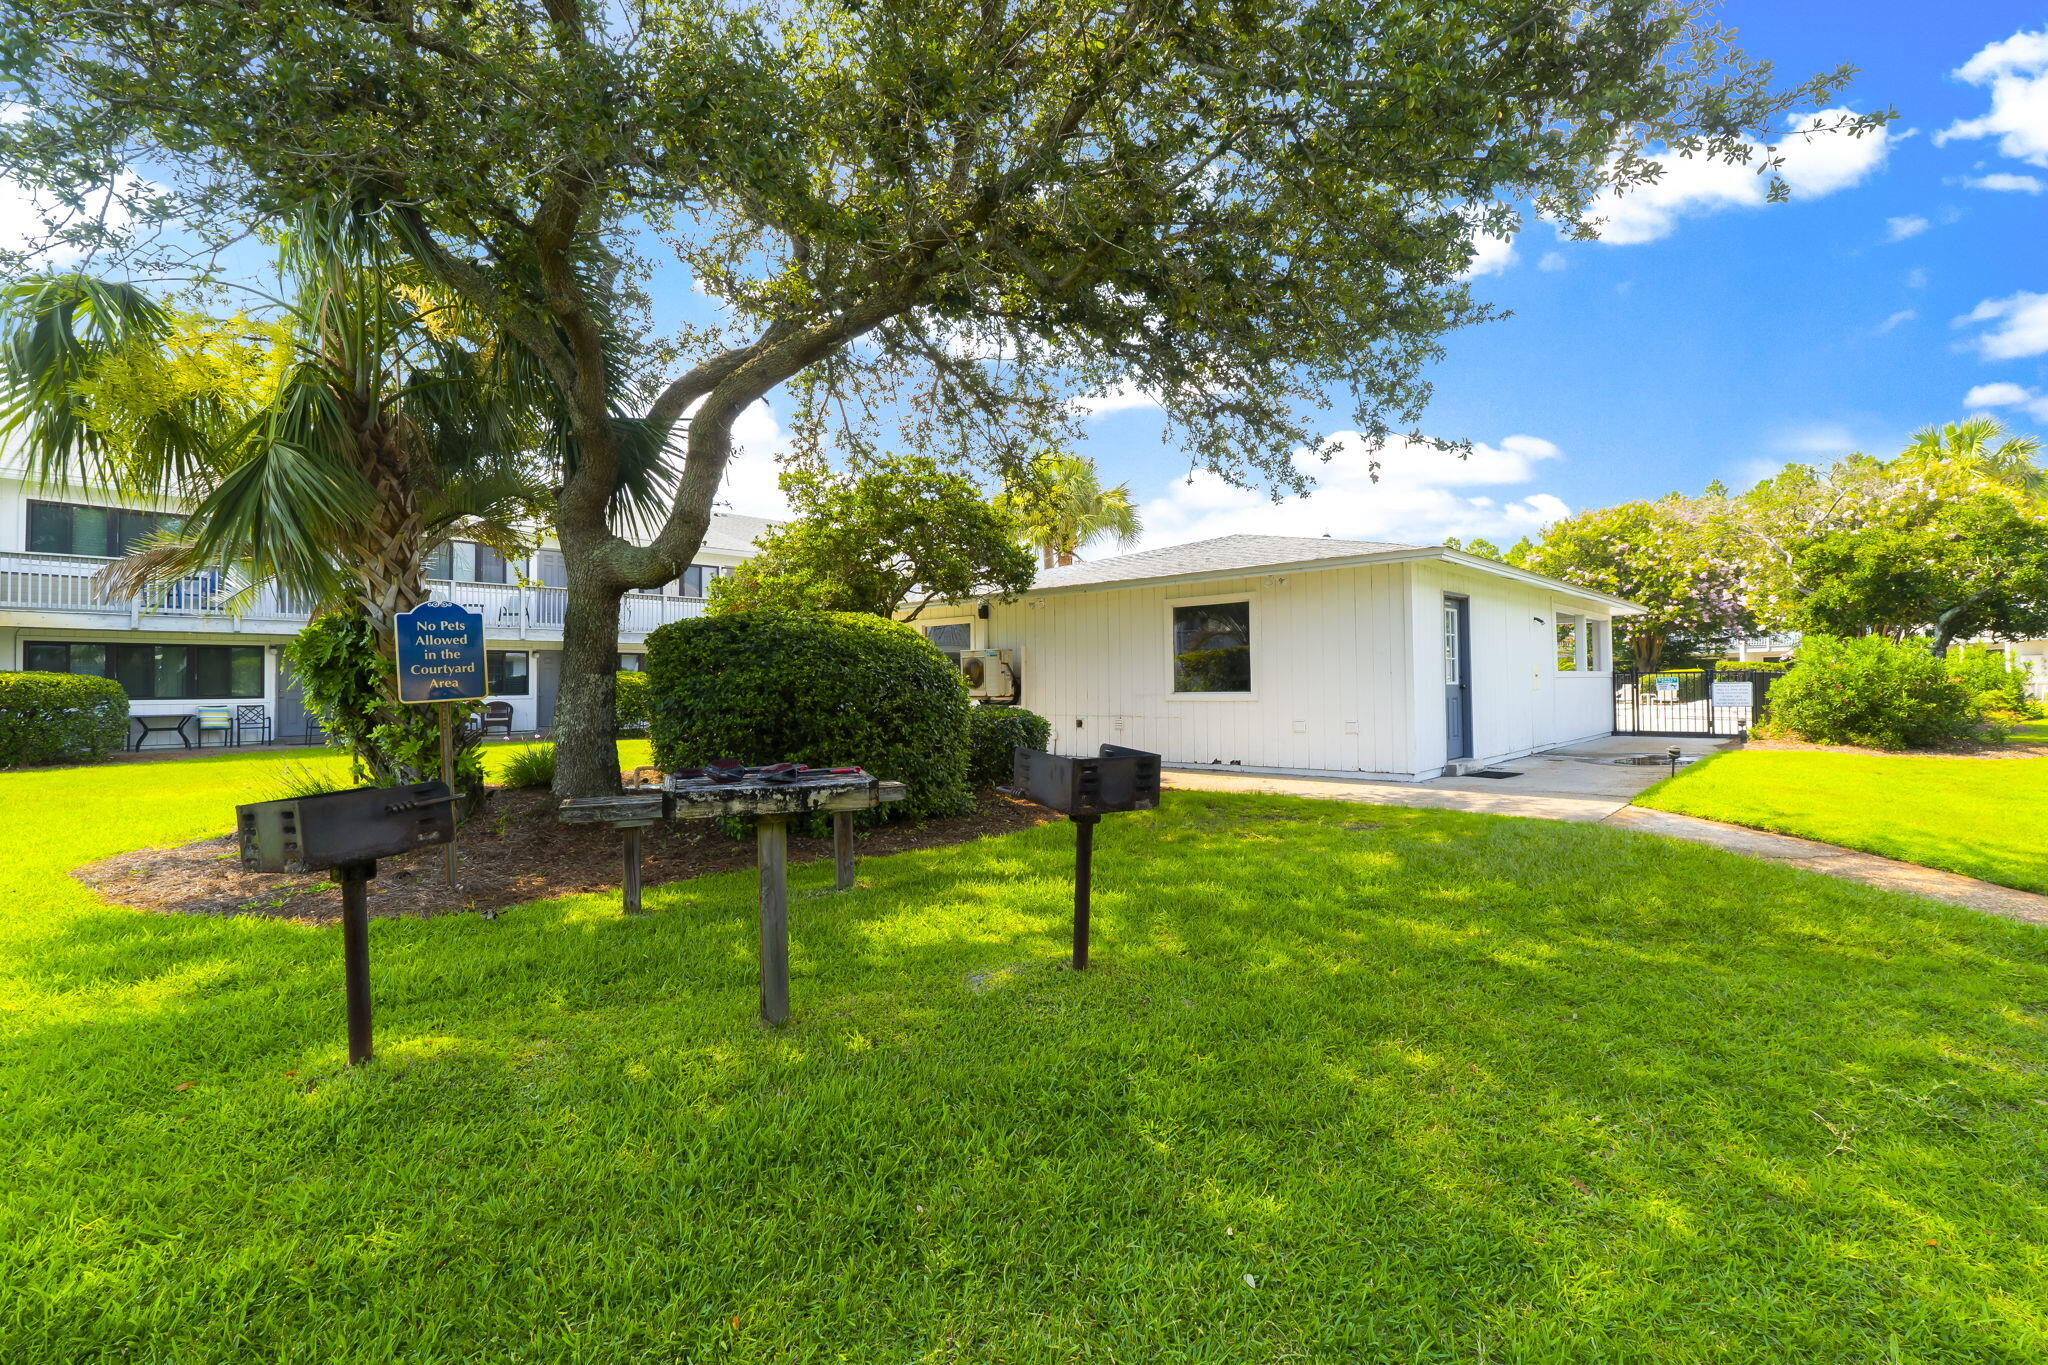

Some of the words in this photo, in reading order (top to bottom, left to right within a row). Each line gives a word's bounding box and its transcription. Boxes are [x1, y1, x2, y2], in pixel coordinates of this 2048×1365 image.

[416, 621, 436, 631] No
[440, 621, 466, 631] Pets
[415, 634, 468, 646] Allowed
[424, 650, 436, 660] in
[441, 649, 461, 659] the
[410, 662, 475, 677] Courtyard
[429, 679, 459, 689] Area
